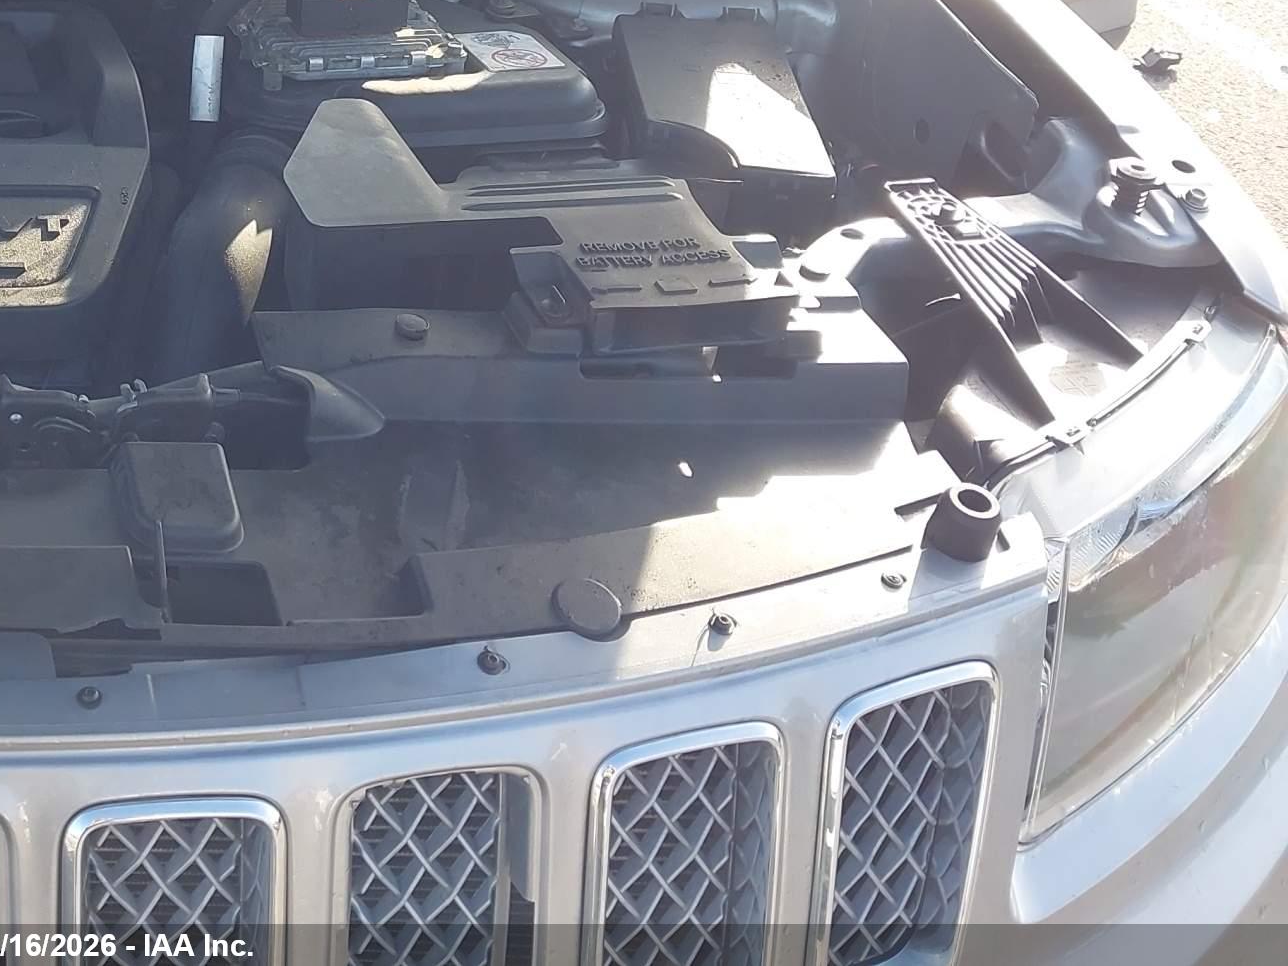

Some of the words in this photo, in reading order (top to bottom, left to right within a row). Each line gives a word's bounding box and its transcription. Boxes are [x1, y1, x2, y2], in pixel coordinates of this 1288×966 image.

[579, 240, 659, 254] REMOVE
[663, 236, 700, 251] FOR
[576, 254, 654, 268] BATTERY
[659, 248, 732, 265] ACCESS
